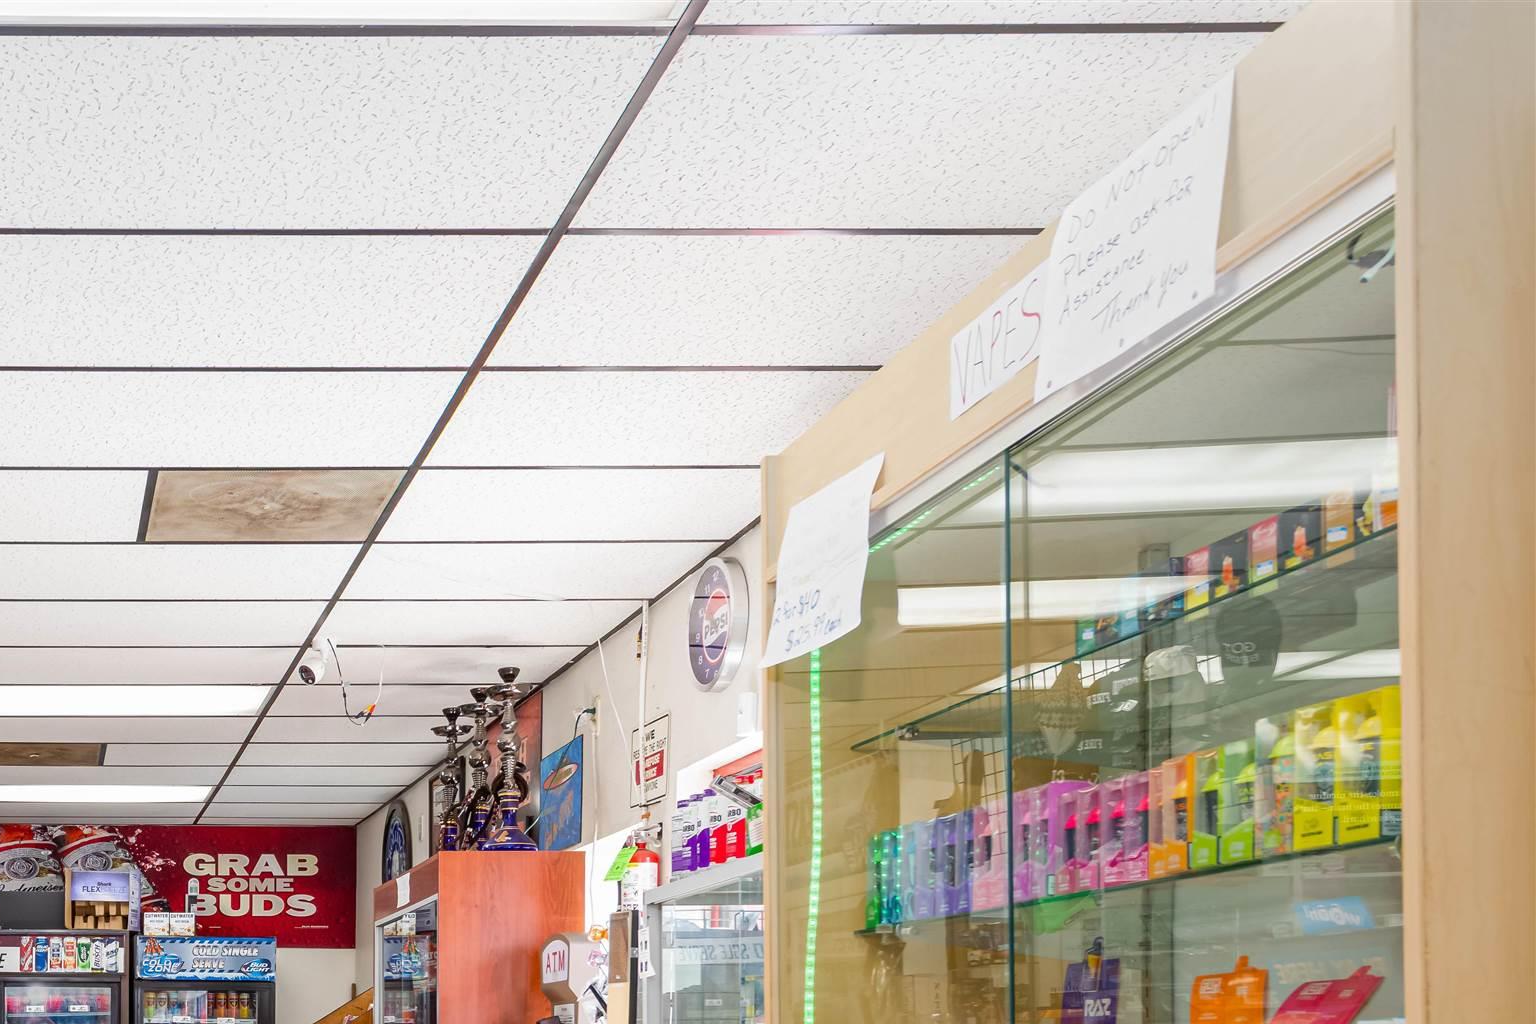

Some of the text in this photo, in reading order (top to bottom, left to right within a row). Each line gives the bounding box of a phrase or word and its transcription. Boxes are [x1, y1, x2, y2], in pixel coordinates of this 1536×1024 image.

[182, 852, 320, 877] GRAB
[206, 877, 295, 893] SOME
[184, 893, 317, 917] BUDS
[192, 945, 259, 957] COLD SINGLE
[191, 957, 225, 969] SERVE
[545, 949, 566, 974] ATM
[1083, 998, 1112, 1017] RAZ
